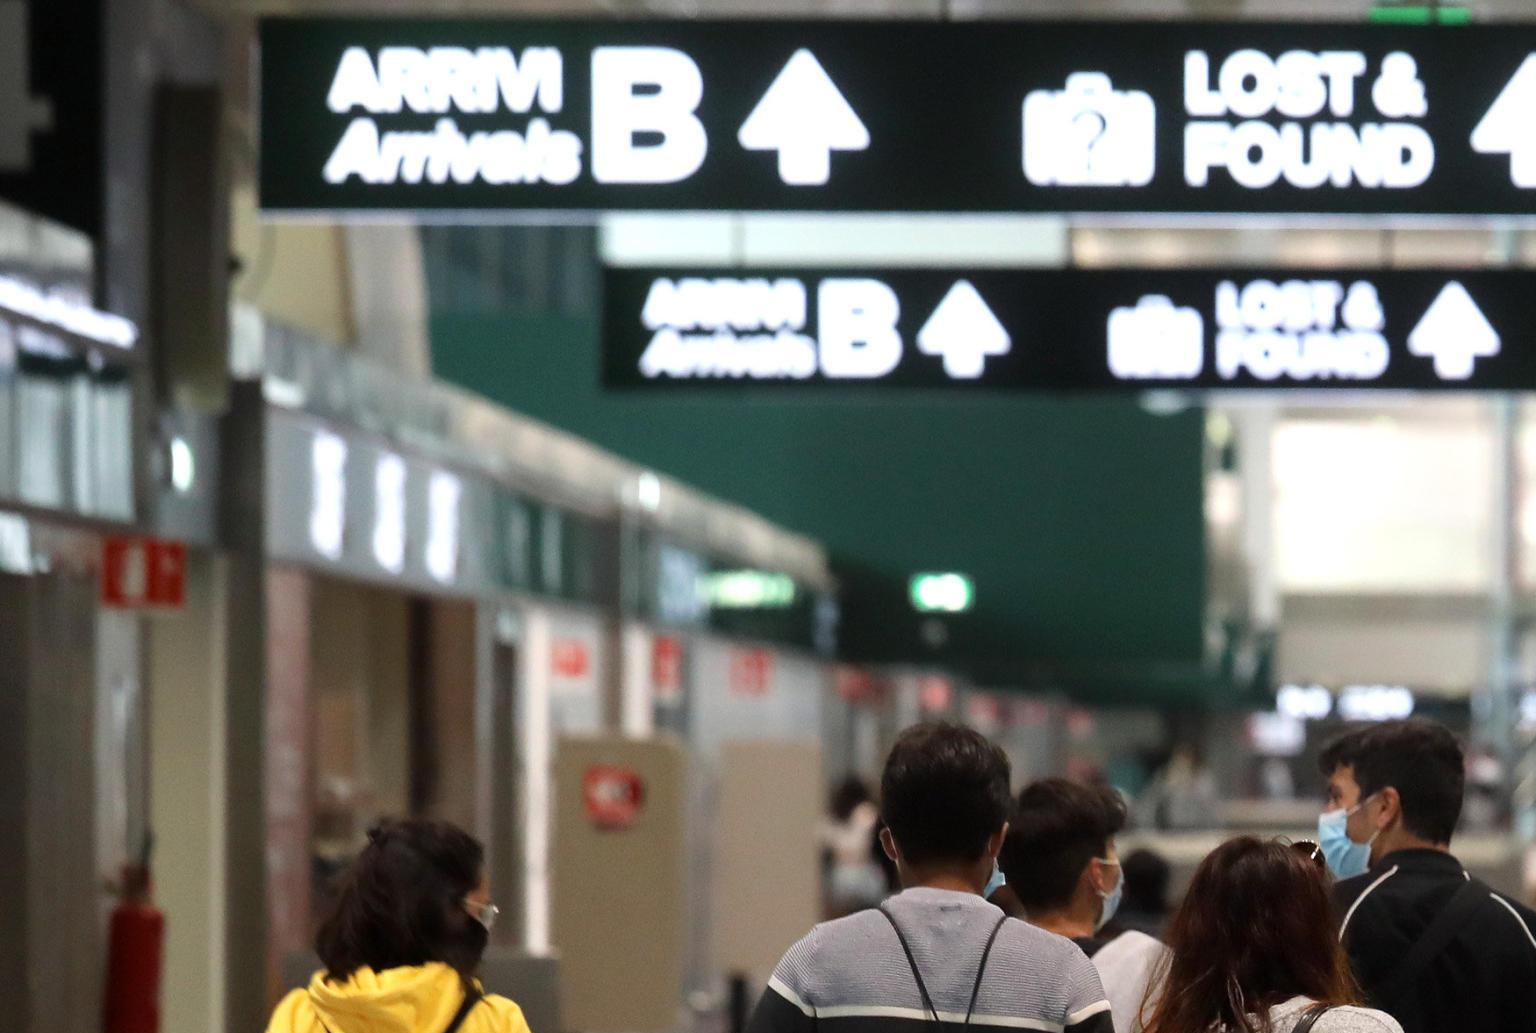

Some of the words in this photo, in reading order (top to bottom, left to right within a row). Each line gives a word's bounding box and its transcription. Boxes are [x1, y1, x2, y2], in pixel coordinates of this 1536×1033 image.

[327, 46, 564, 113] ARRIVI
[1184, 49, 1366, 118] LOST
[1372, 51, 1428, 118] &
[591, 46, 708, 184] B
[324, 117, 583, 185] Arrivals
[1184, 120, 1435, 188] FOUND
[817, 278, 903, 379] B
[1216, 280, 1341, 331] LOST
[1216, 331, 1390, 380] FOUND
